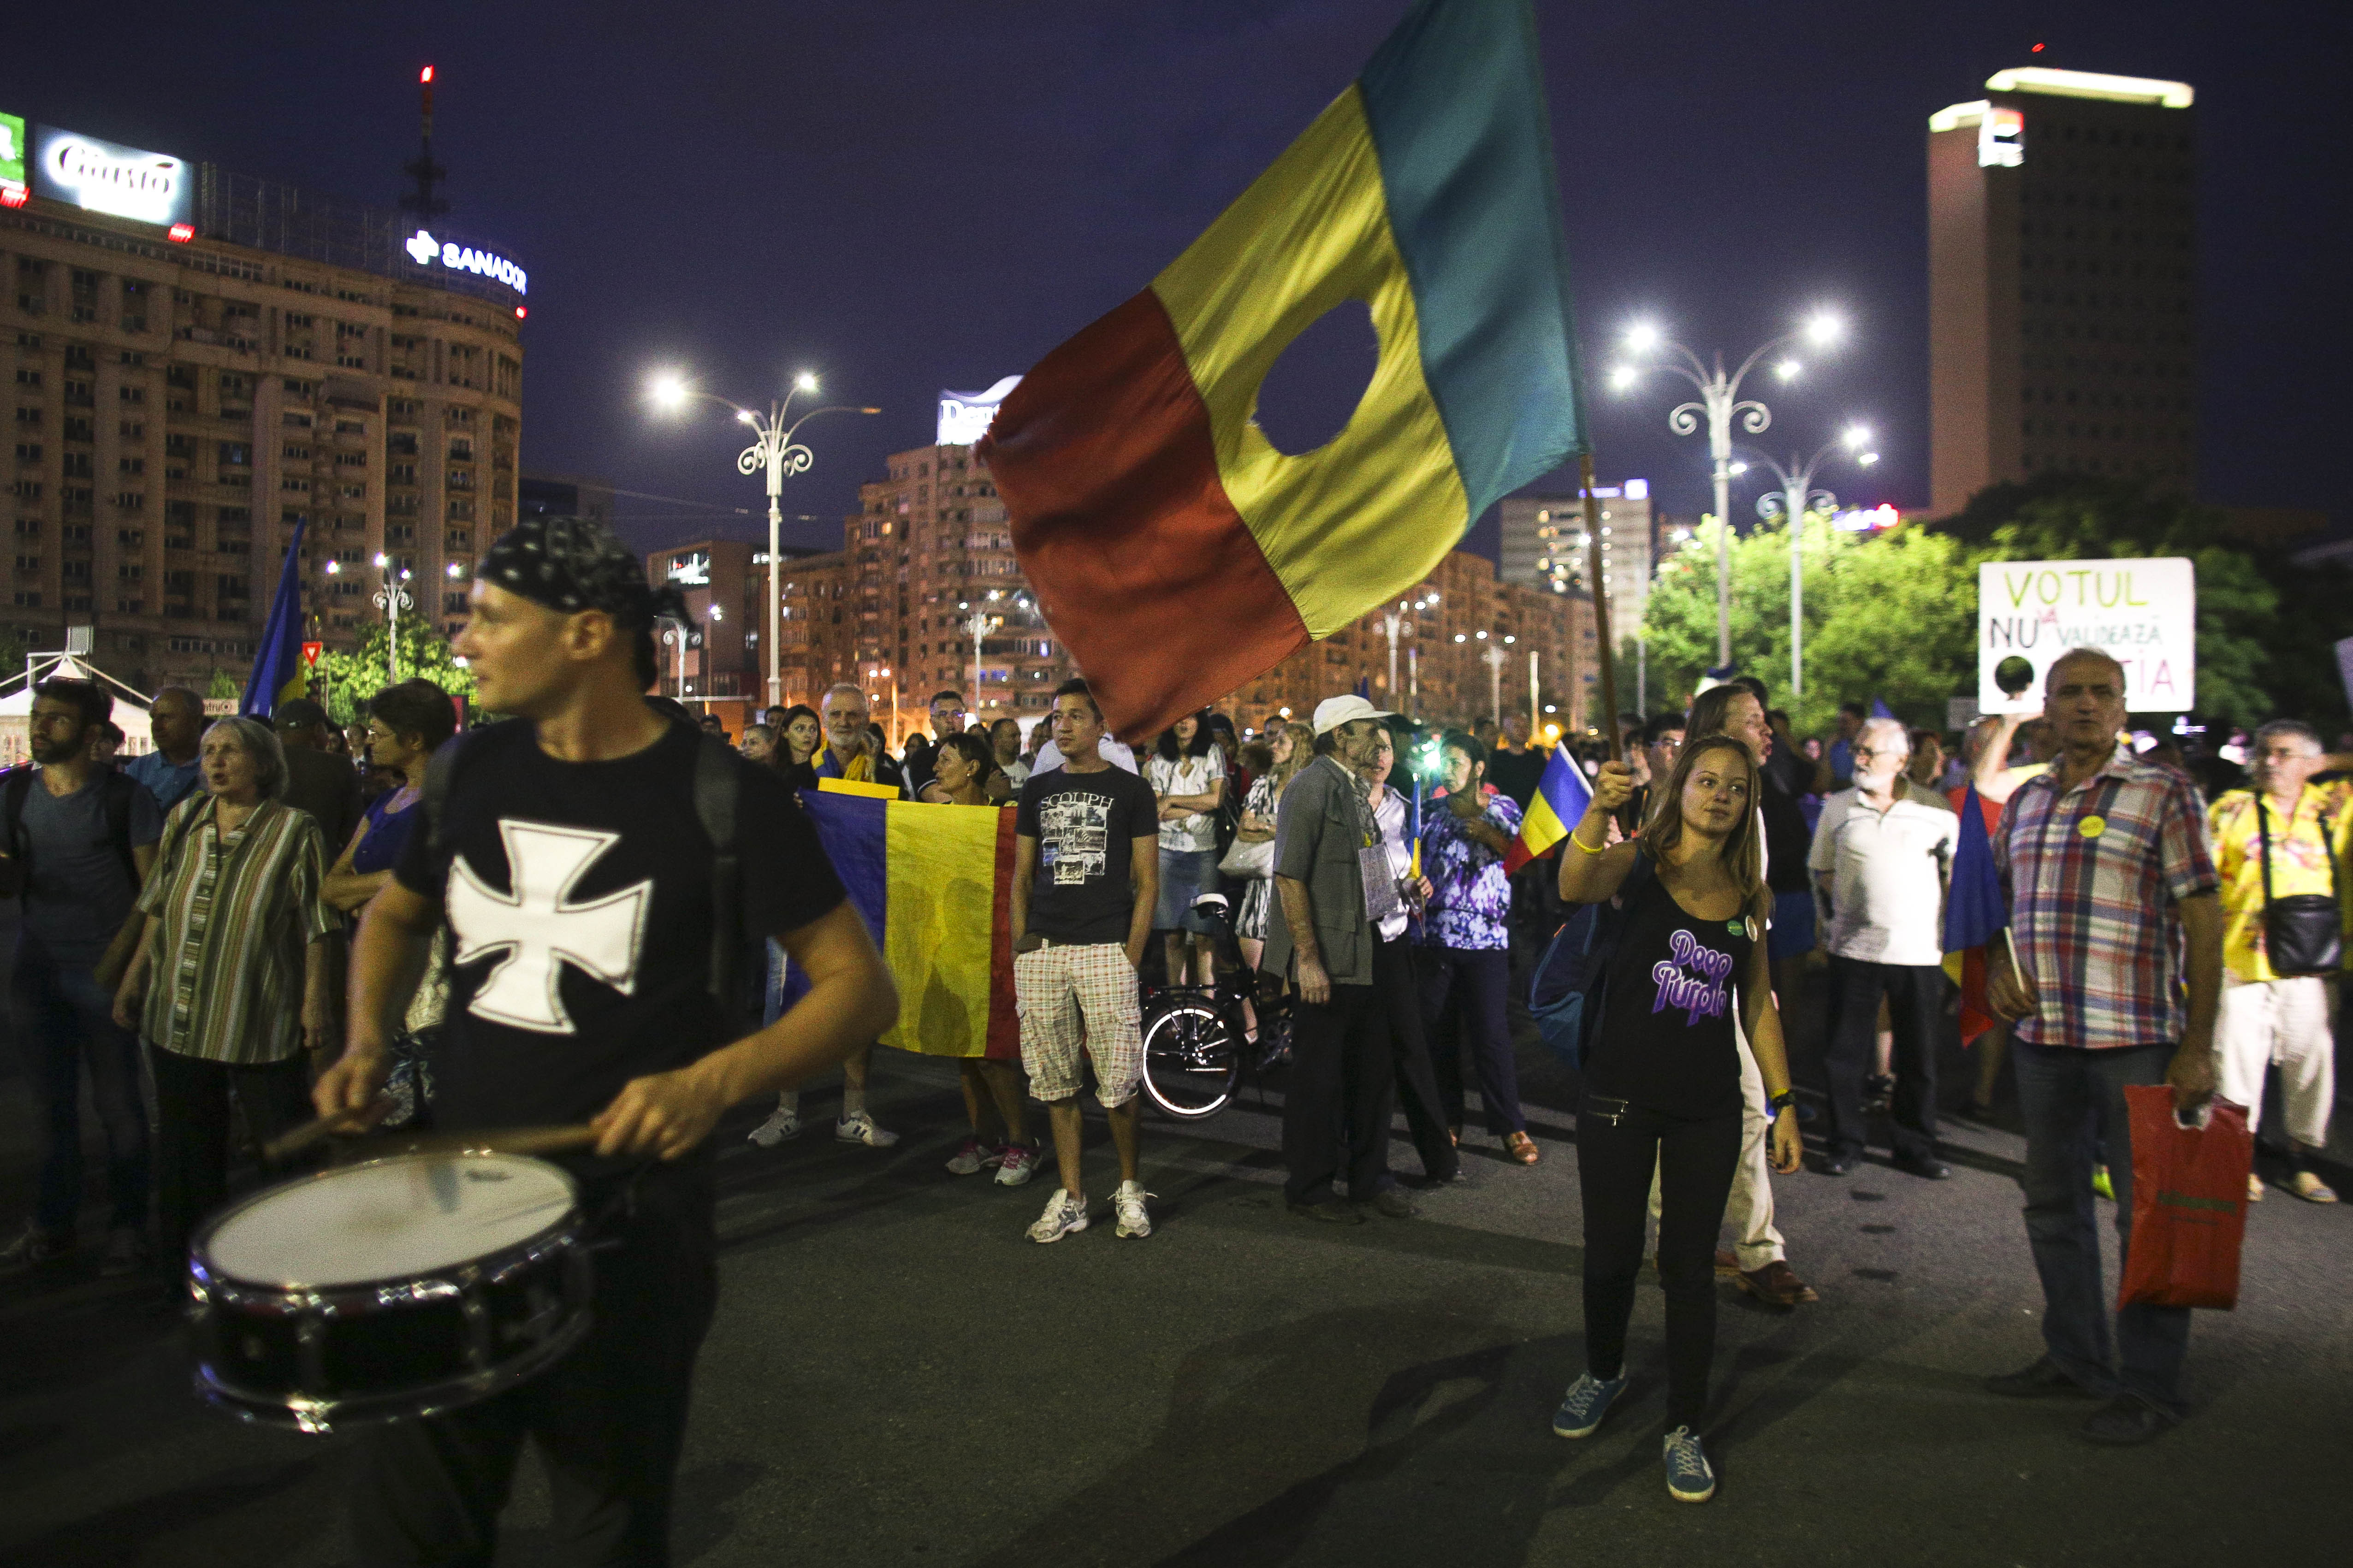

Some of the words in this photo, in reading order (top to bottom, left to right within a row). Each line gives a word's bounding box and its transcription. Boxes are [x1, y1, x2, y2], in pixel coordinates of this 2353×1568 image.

[441, 242, 527, 296] SANADOR
[2004, 569, 2148, 609] VOTUL
[1990, 616, 2039, 649] NU
[1670, 929, 1733, 989] Deep
[1652, 960, 1727, 1027] Purple
